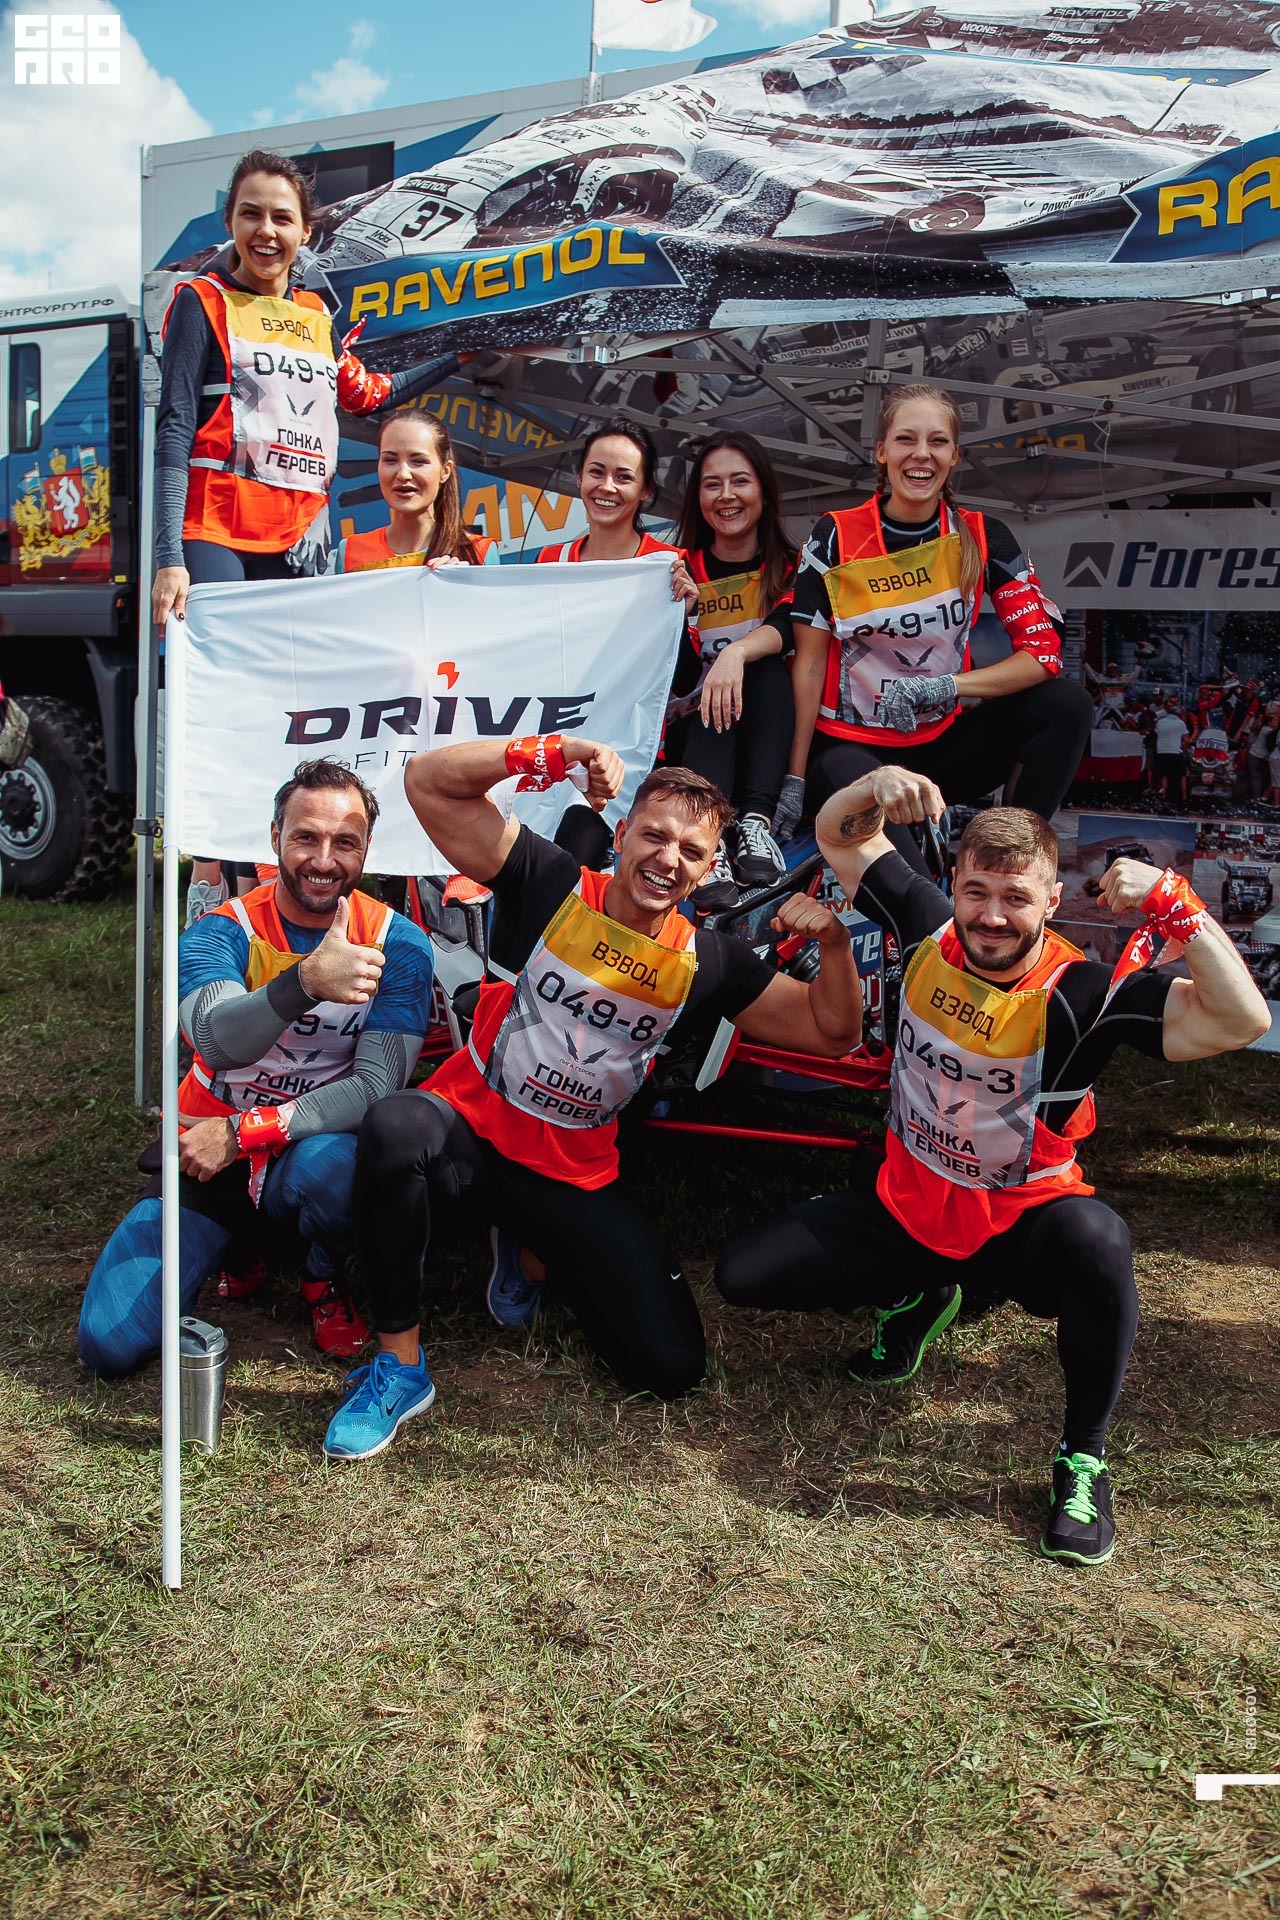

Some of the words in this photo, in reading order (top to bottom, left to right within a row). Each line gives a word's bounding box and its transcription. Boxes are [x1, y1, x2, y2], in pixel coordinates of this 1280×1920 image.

[960, 22, 998, 34] MOONS
[1043, 33, 1100, 45] Snap-on
[401, 200, 464, 241] 37
[350, 227, 645, 322] RAVENOL
[261, 317, 314, 343] ВЗВОД
[253, 351, 339, 391] 049-9
[277, 428, 323, 453] ГОНКА
[265, 450, 326, 477] ГЕРОЕВ
[867, 566, 932, 593] ВЗВОД
[698, 593, 744, 617] ЗВОД
[284, 661, 597, 745] DRIVE
[591, 941, 659, 992] ВЗВОД
[293, 1010, 361, 1038] 9-4
[536, 970, 658, 1042] 049-8
[930, 986, 995, 1041] ВЗВОД
[900, 1018, 1016, 1094] 049-3
[518, 1082, 598, 1120] ГЕРОЕВ
[534, 1062, 602, 1103] ГОНКА
[910, 1106, 977, 1157] ГОНКА
[907, 1127, 981, 1178] ГЕРОЕВ
